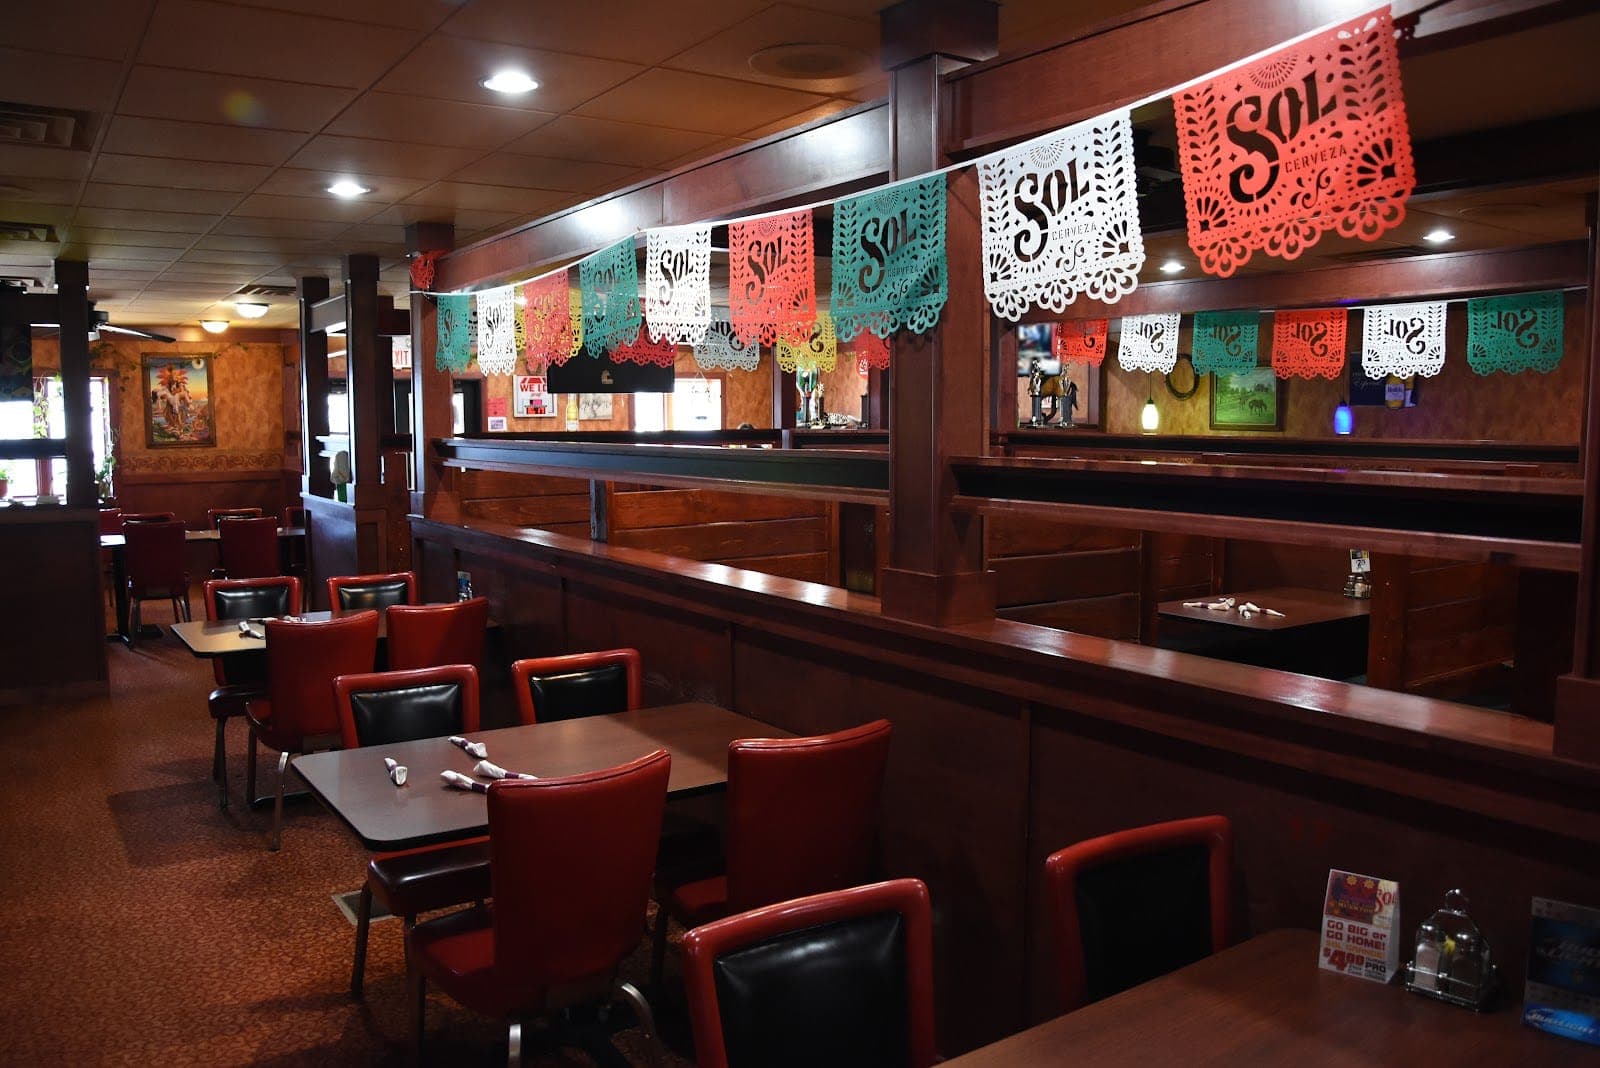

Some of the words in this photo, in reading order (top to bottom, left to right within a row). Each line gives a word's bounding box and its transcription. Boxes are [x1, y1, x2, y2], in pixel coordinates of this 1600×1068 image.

[1226, 69, 1337, 203] SOL
[1284, 145, 1347, 174] CERVEZA
[1014, 157, 1090, 262] SOL
[1052, 222, 1097, 241] CERVEZA
[746, 236, 788, 304] SOL
[858, 208, 917, 293] SOL
[660, 249, 693, 306] SOL
[486, 304, 506, 349] SOL
[393, 350, 409, 366] XIT
[1326, 930, 1343, 941] GO
[1347, 935, 1385, 951] HOME!
[1327, 919, 1343, 930] GO
[1348, 924, 1368, 936] BIG
[1372, 931, 1386, 941] or
